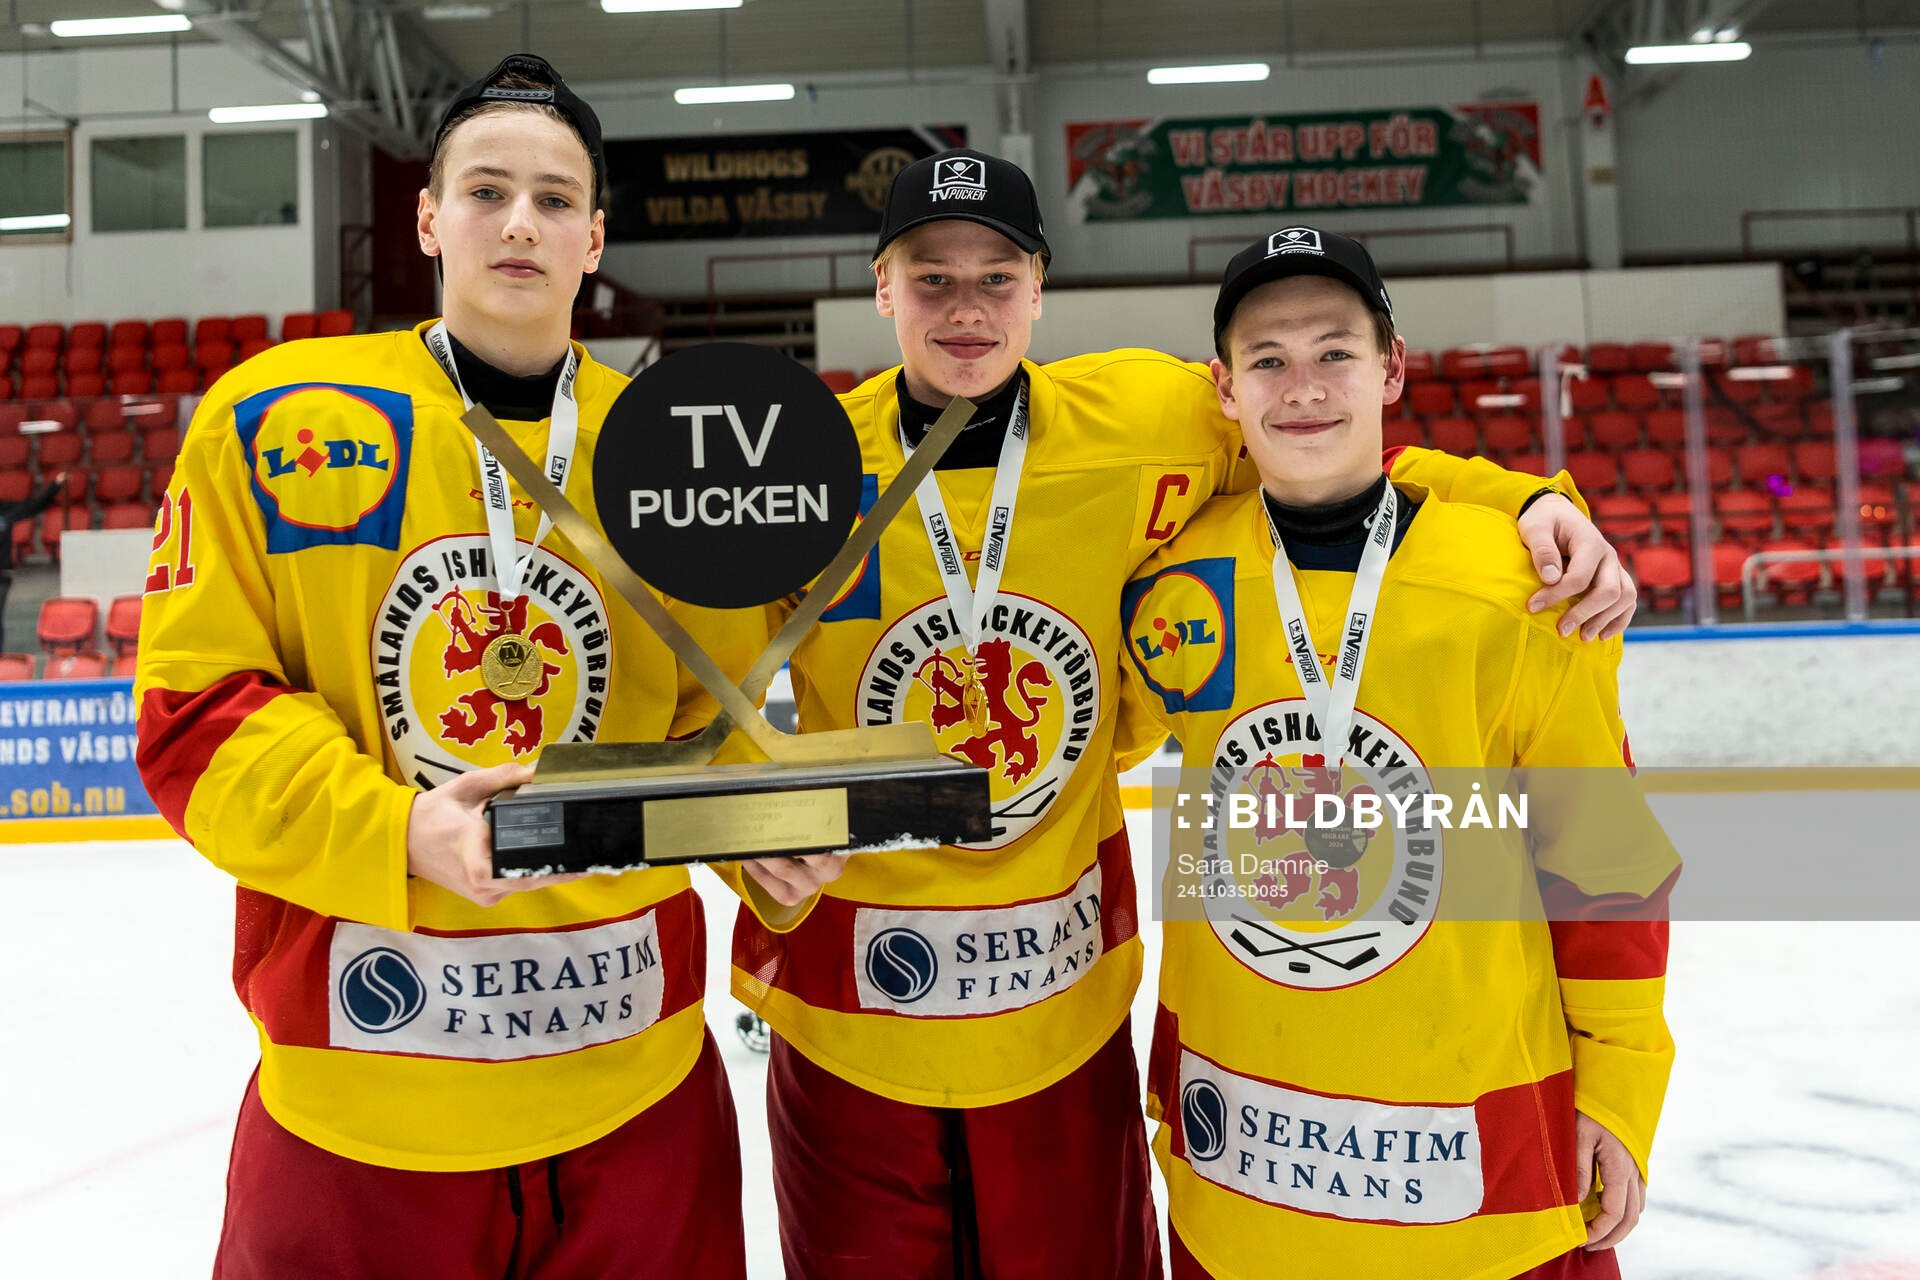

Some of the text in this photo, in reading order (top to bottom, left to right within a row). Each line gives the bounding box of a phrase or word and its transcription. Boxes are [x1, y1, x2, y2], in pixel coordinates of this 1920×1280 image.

[1168, 114, 1439, 166] VI STÅR UPP FÖR
[663, 149, 809, 182] WILDHOGS
[1295, 166, 1428, 208] HOCKEY
[646, 195, 730, 225] VILDA
[670, 403, 782, 469] TV
[629, 484, 829, 529] PUCKEN
[1144, 473, 1191, 541] C
[441, 547, 609, 743] ISHCKEYFÖRBUN
[0, 692, 136, 727] EVERANTÖ
[0, 736, 51, 765] NDS
[0, 781, 126, 817] .sob.nu
[441, 935, 658, 998] SERAFIM
[957, 939, 1095, 1001] FINANS
[443, 993, 634, 1040] FINANS
[1239, 1104, 1470, 1164] SERAFIM
[1237, 1149, 1425, 1205] FINANS
